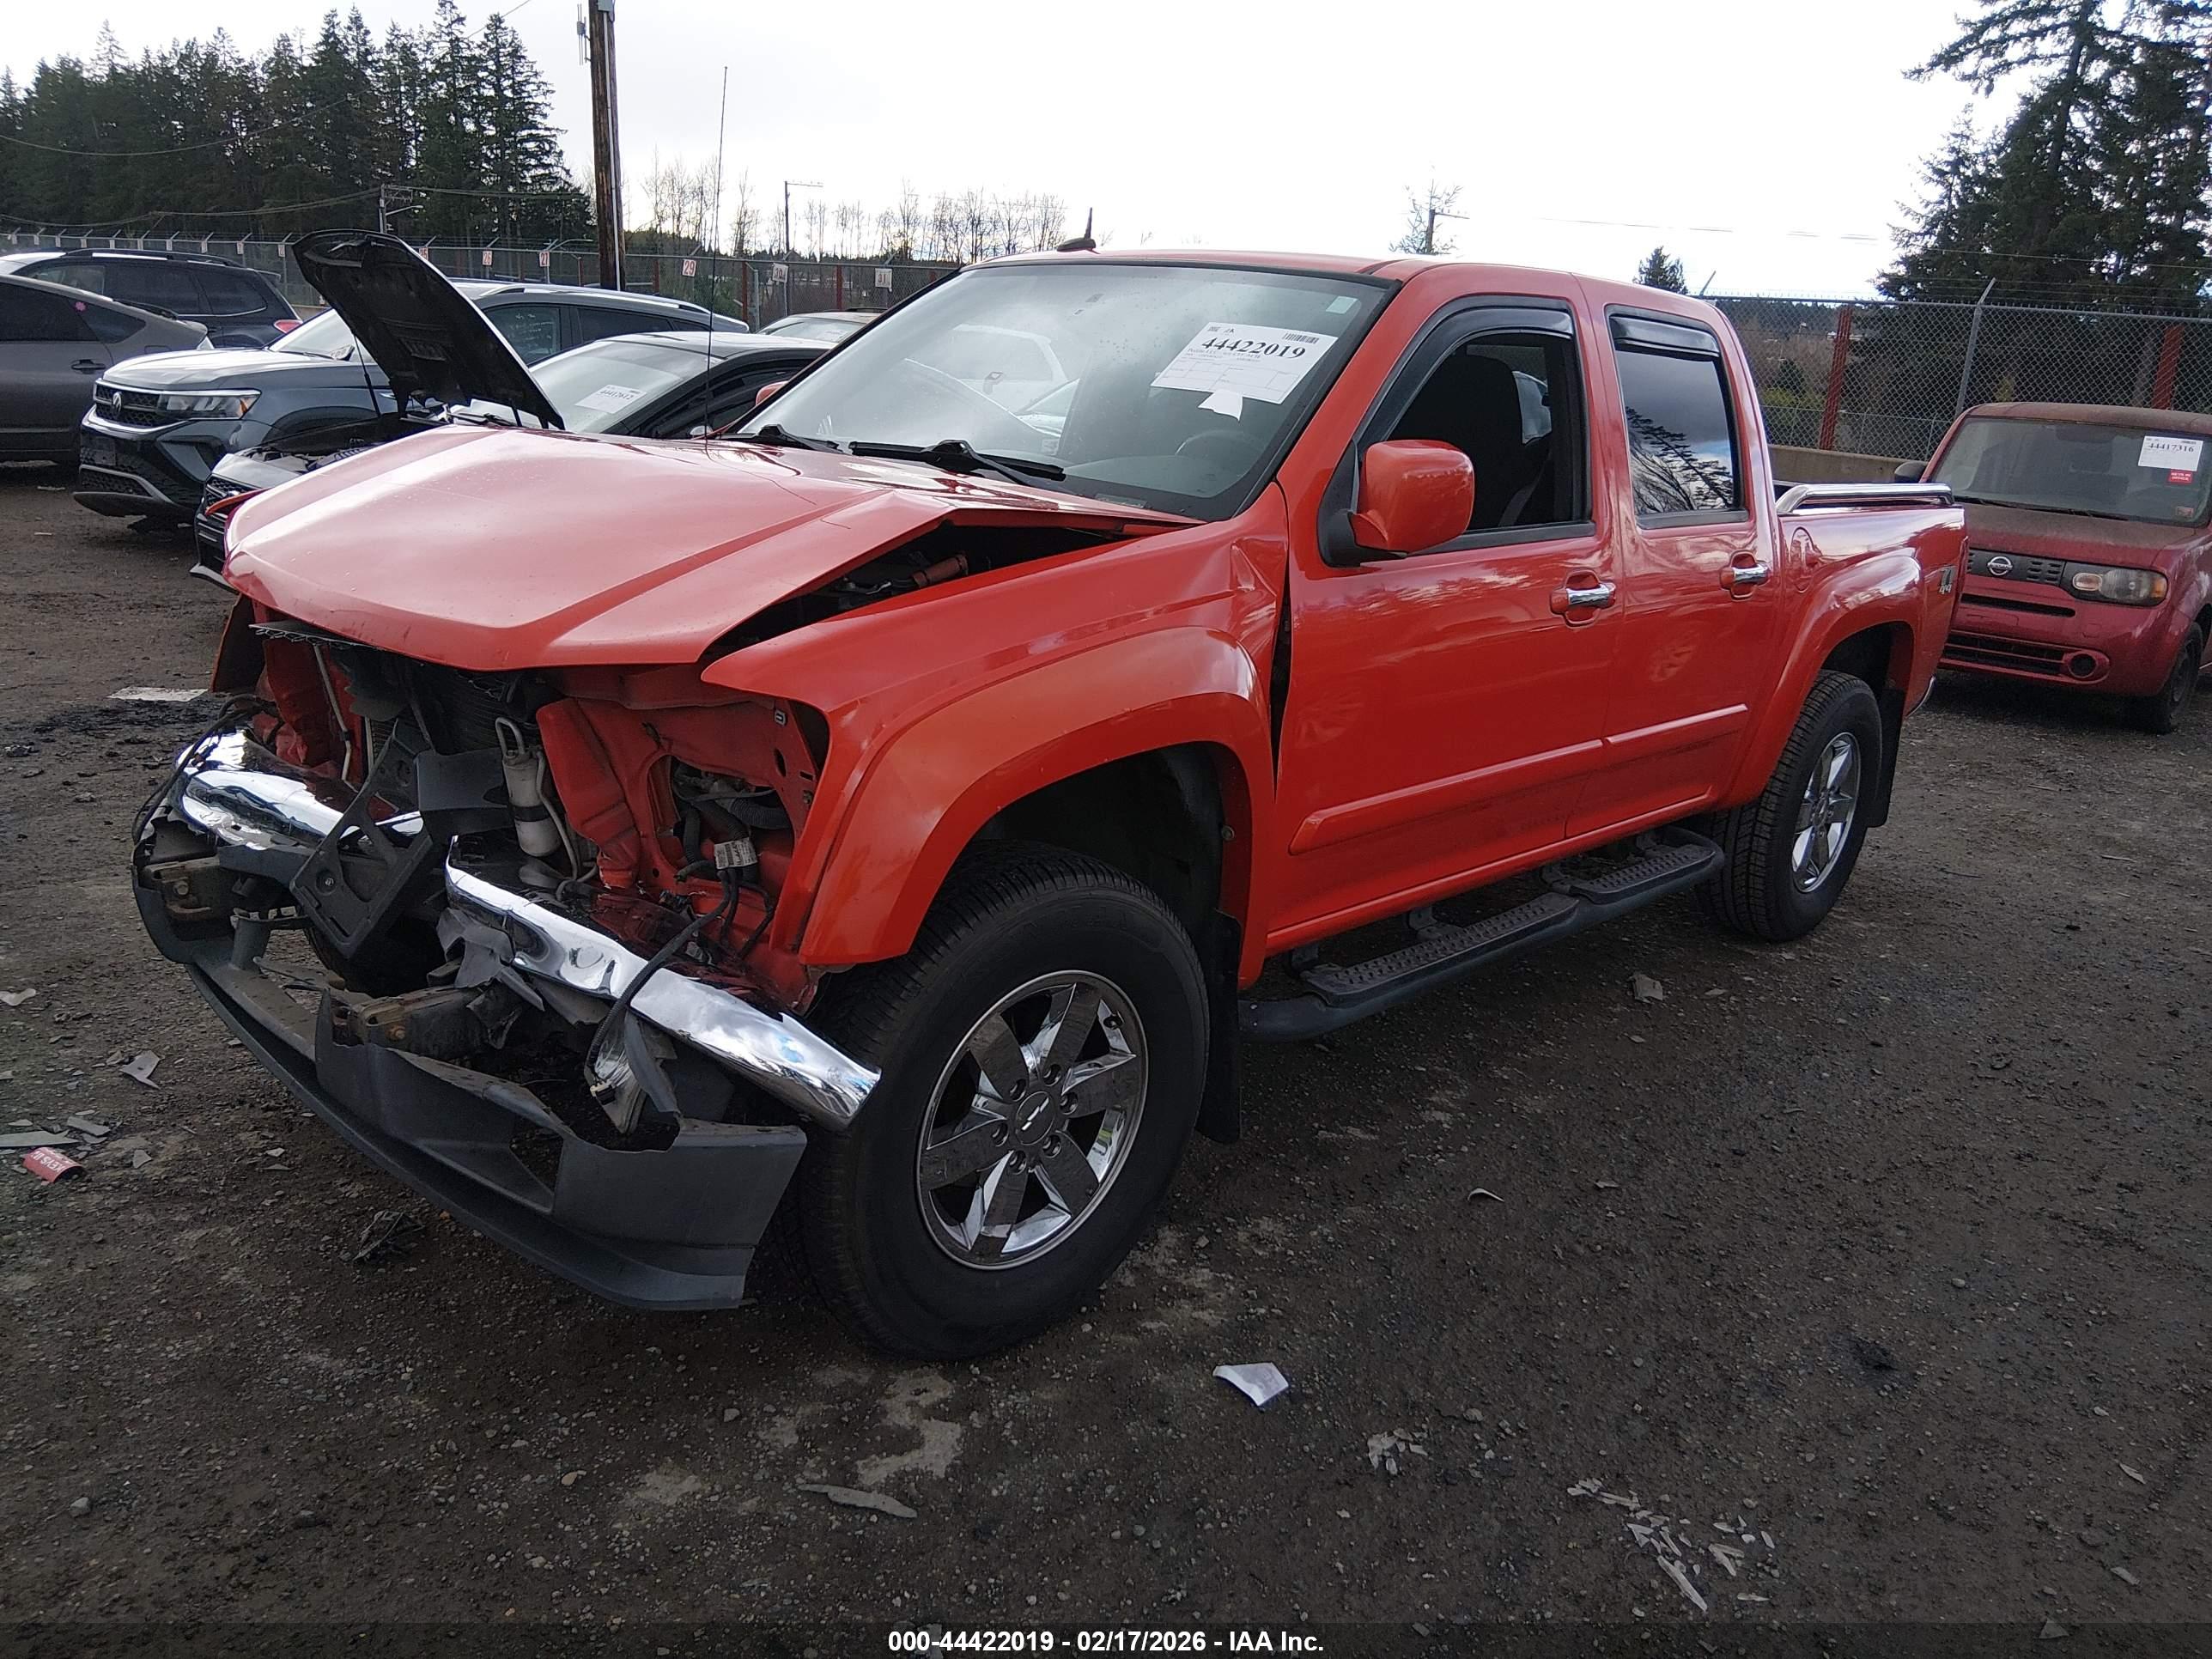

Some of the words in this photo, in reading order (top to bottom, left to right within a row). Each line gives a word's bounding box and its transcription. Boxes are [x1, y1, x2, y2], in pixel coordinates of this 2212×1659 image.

[483, 252, 491, 264] 26
[540, 252, 549, 266] 27
[684, 260, 696, 276] 29
[1202, 337, 1306, 359] 44422019
[40, 1156, 65, 1173] KEYS
